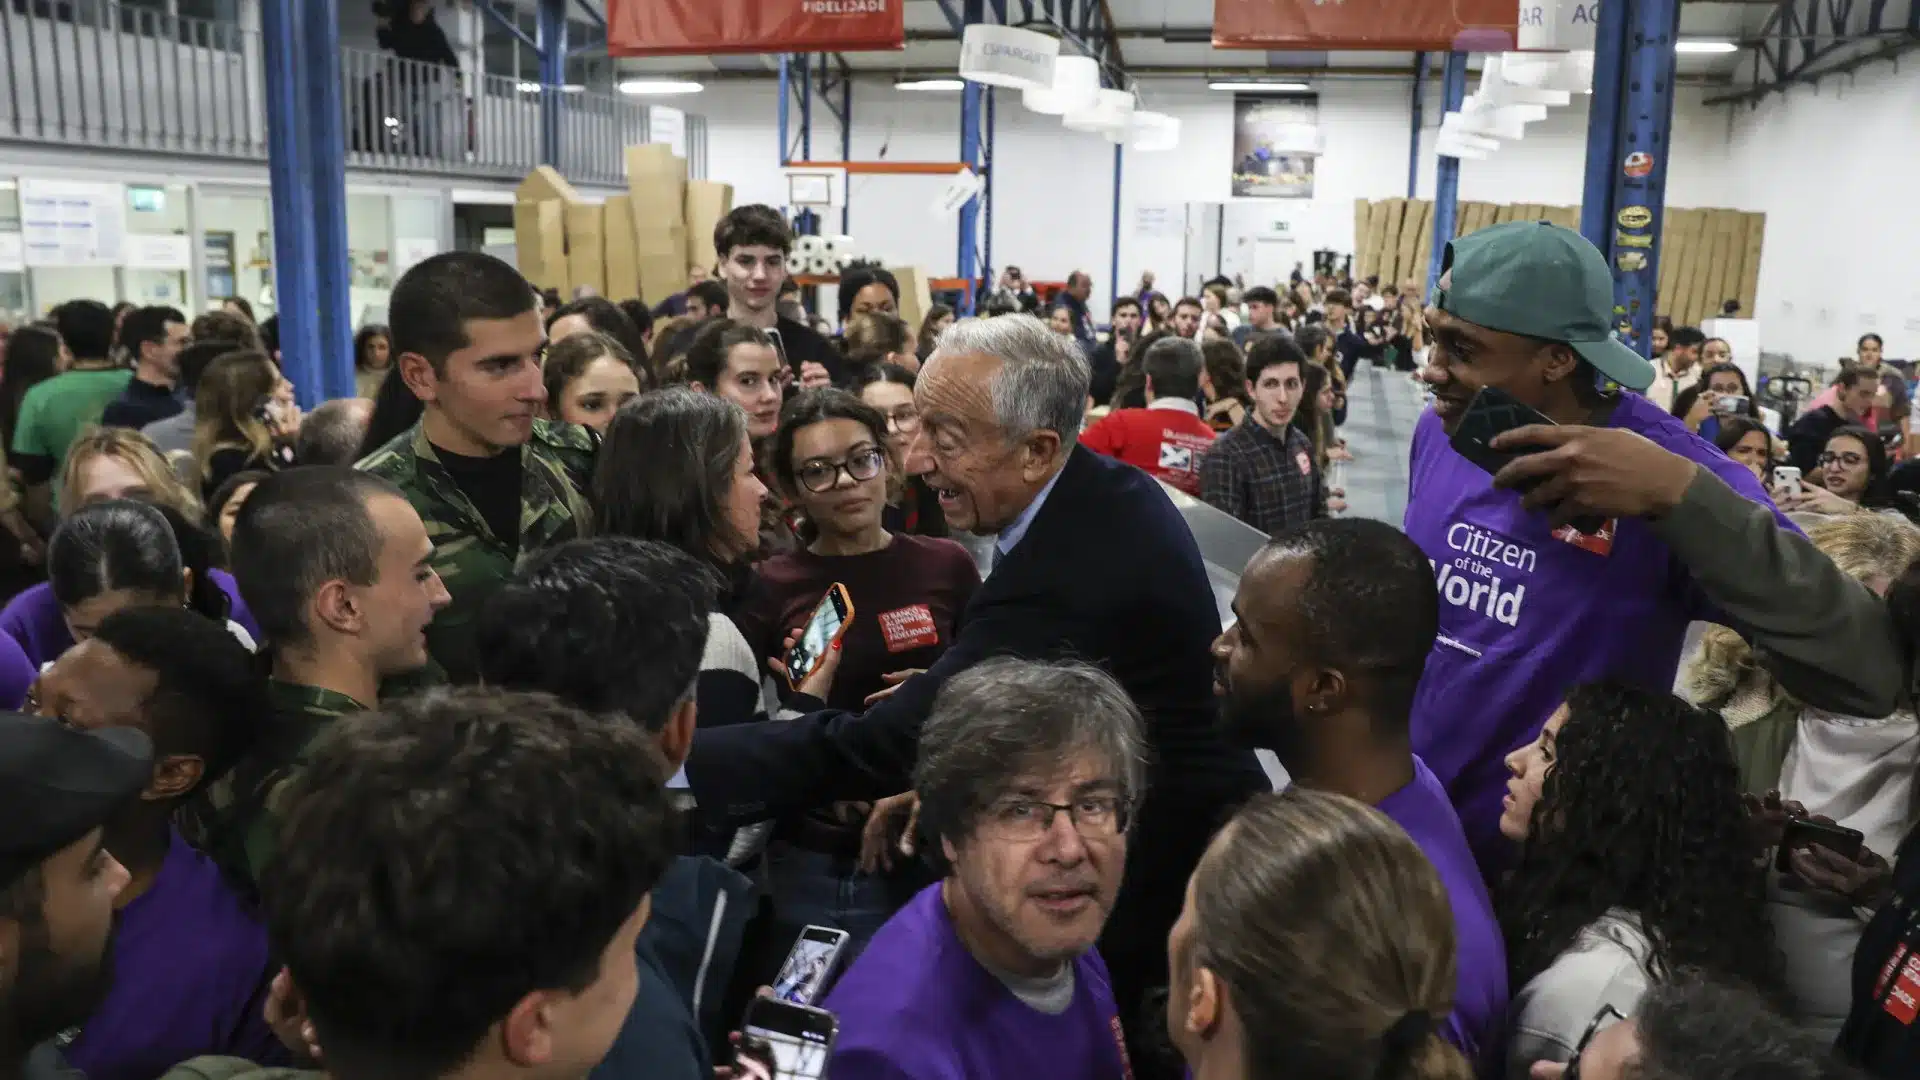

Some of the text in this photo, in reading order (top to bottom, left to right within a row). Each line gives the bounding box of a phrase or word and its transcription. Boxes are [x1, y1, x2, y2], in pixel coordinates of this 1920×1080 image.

[802, 0, 886, 13] FIDELIDADE
[1447, 522, 1537, 573] Citizen
[1454, 557, 1493, 579] of the
